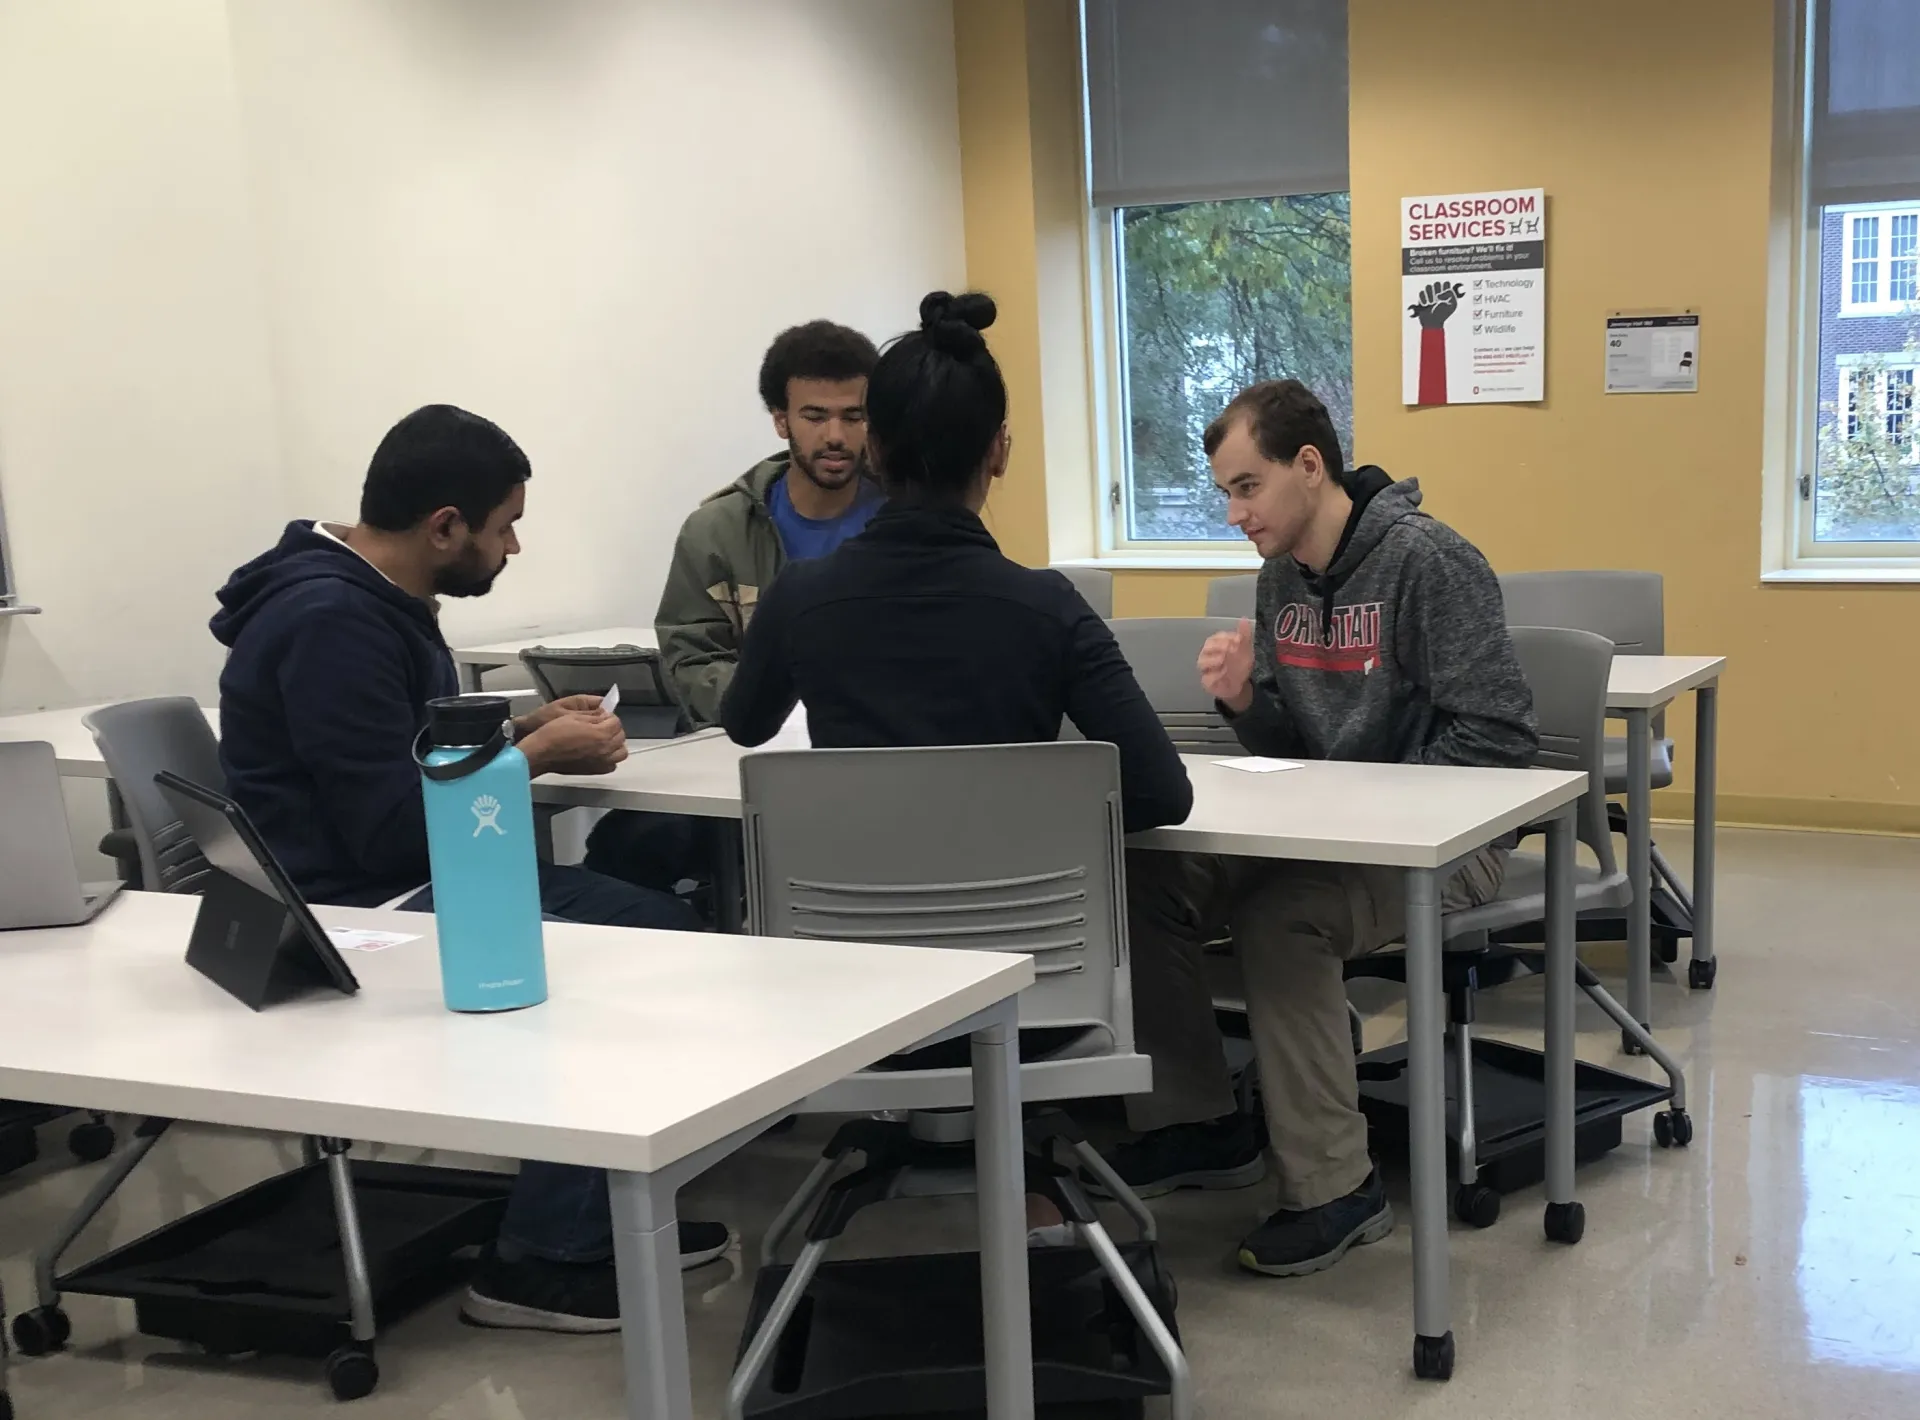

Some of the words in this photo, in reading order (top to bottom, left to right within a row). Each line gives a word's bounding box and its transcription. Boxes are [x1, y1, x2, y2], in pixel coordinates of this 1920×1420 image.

[1409, 196, 1535, 220] CLASSROOM
[1409, 219, 1506, 241] SERVICES
[1409, 249, 1437, 257] Broken
[1438, 246, 1475, 255] furniture?
[1409, 257, 1424, 265] Call
[1513, 252, 1530, 262] your
[1409, 265, 1447, 273] classroom
[1485, 278, 1535, 289] Technology
[1484, 294, 1511, 304] HVAC
[1484, 309, 1523, 319] Furniture
[1484, 324, 1516, 334] Wildlife
[1609, 339, 1622, 348] 40
